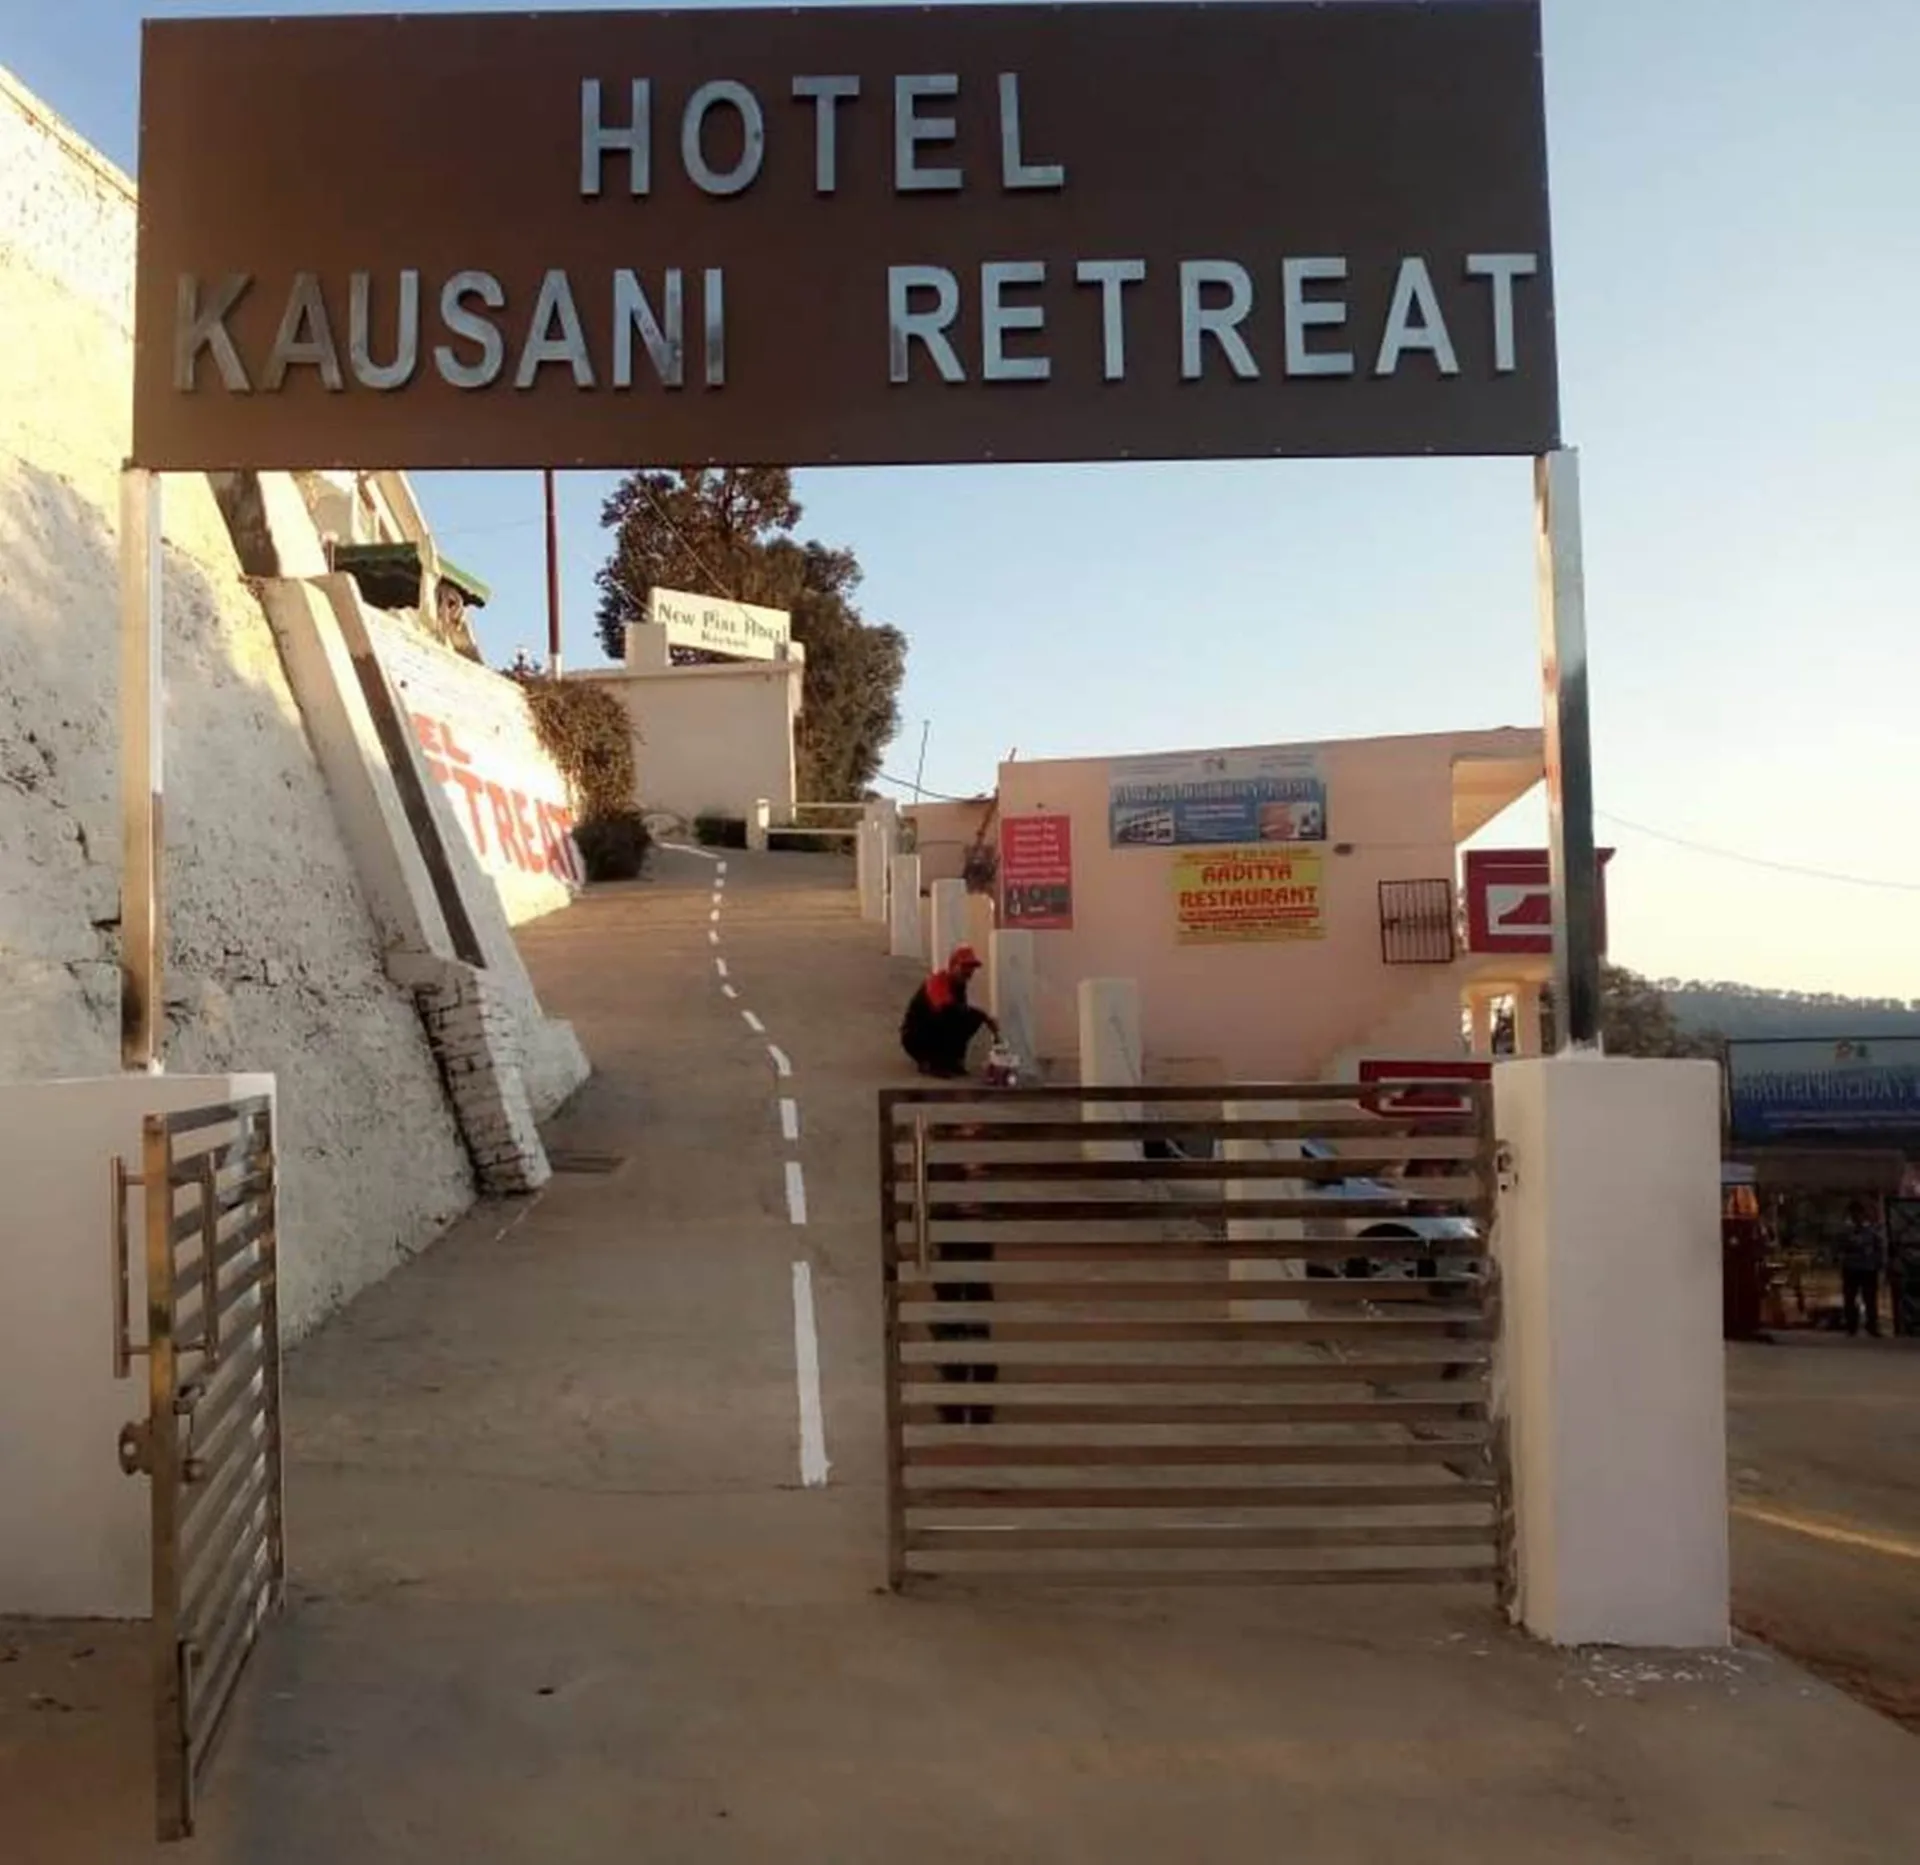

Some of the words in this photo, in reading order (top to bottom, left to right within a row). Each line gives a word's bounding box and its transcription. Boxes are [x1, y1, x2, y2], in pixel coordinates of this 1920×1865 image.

[579, 72, 1065, 197] HOTEL
[172, 267, 725, 394] KAUSANI
[887, 252, 1538, 384] RETREAT
[658, 602, 696, 626] New
[1179, 886, 1318, 909] RESTAURANT
